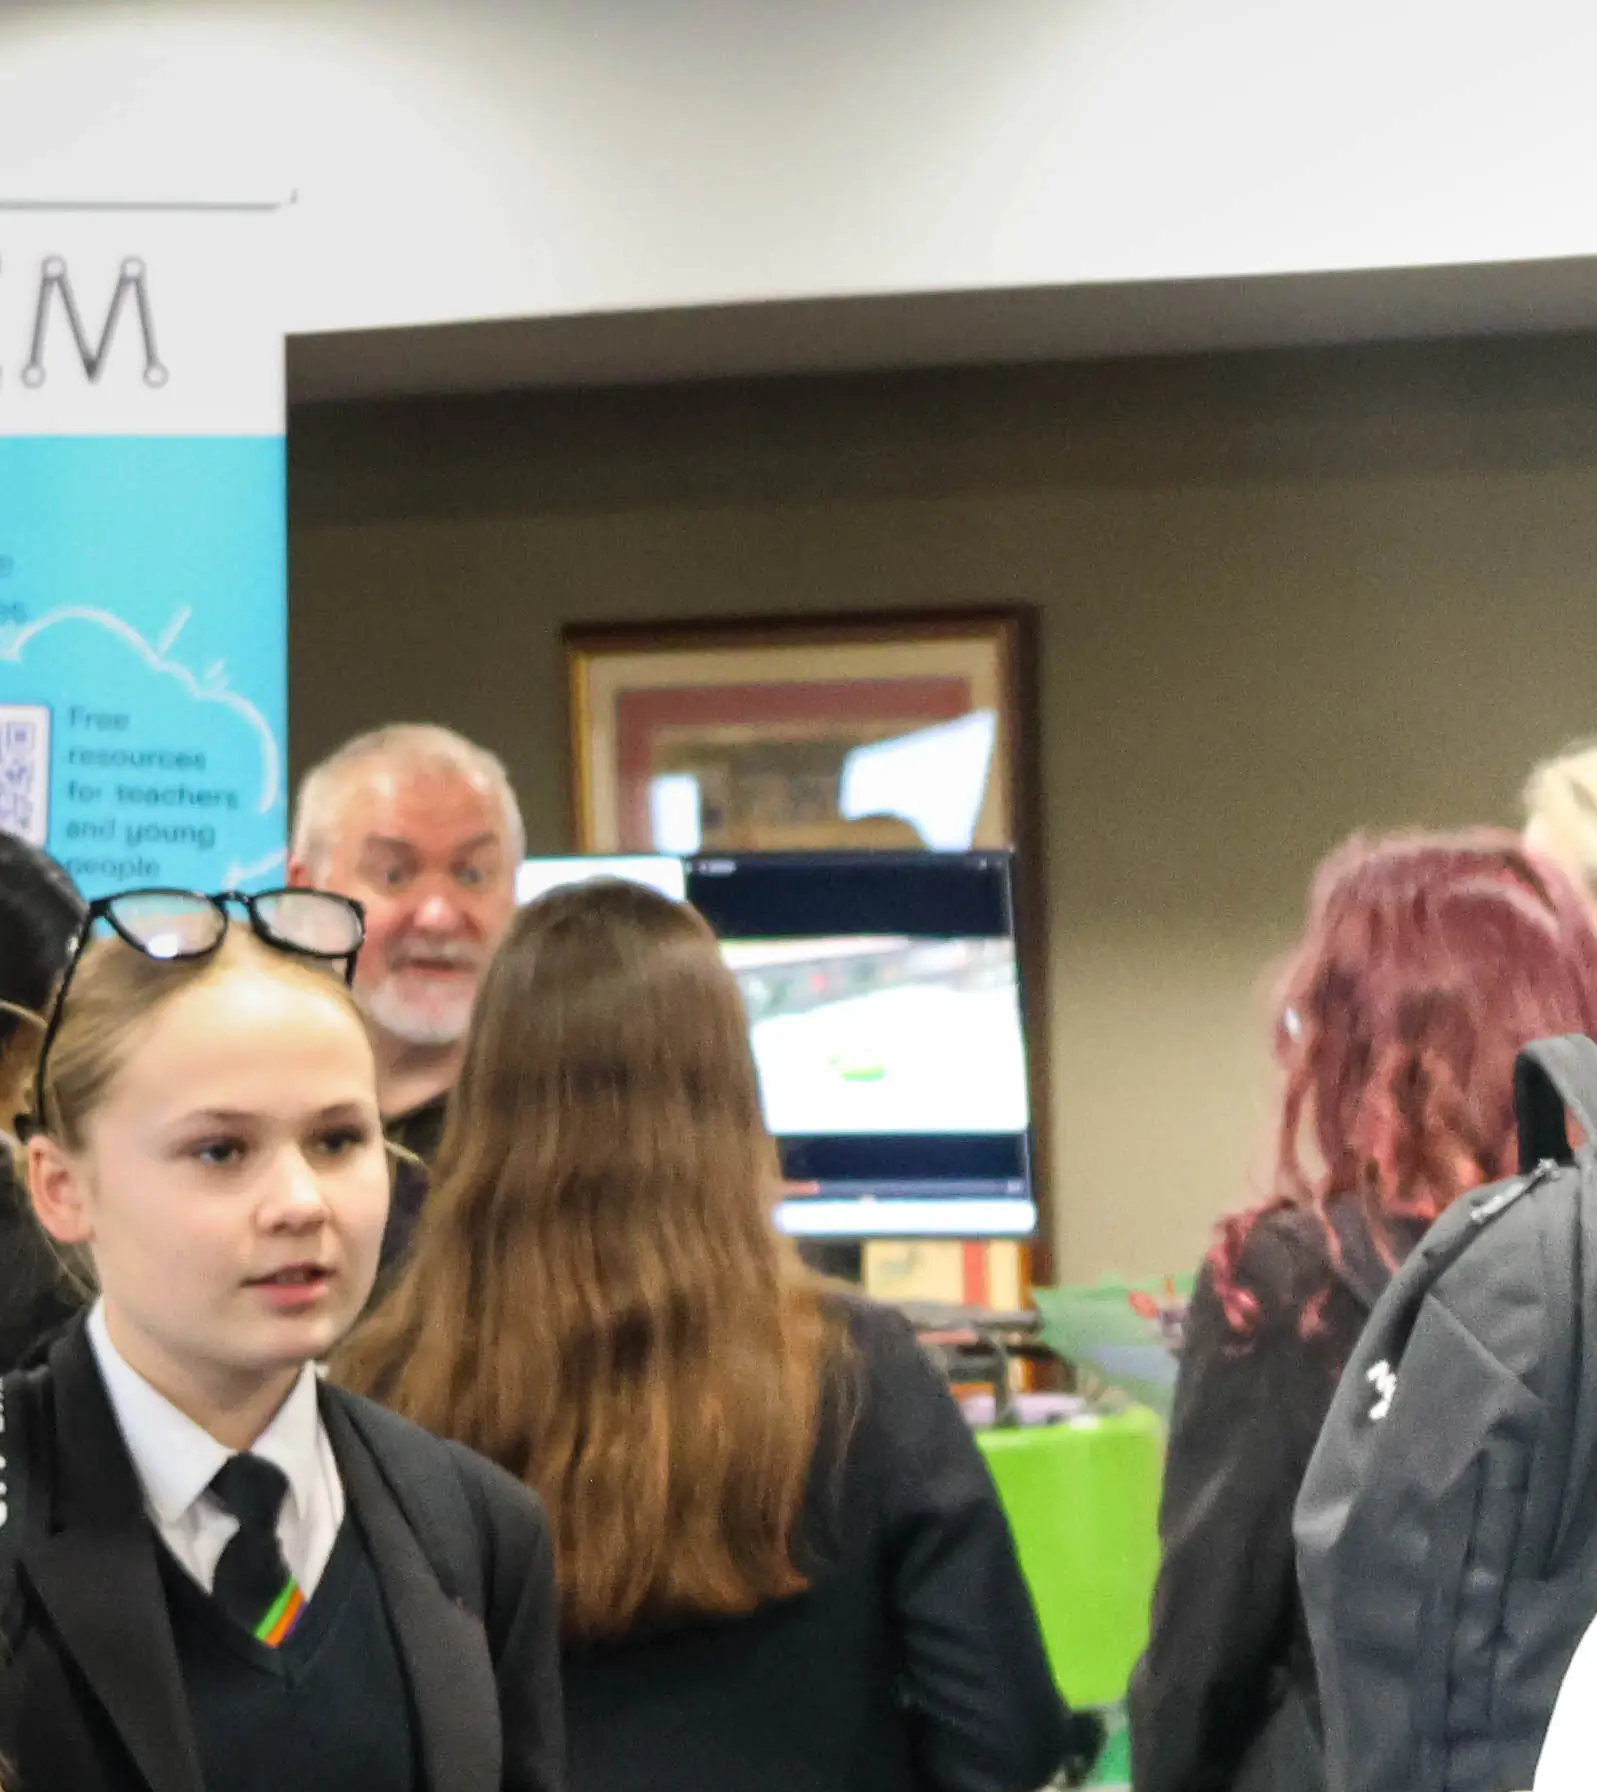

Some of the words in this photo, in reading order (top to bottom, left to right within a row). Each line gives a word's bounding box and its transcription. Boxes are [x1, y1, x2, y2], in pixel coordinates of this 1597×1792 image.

[67, 707, 130, 731] Free
[67, 748, 207, 770] resources
[67, 779, 102, 802] for
[116, 782, 239, 810] teachers
[65, 816, 116, 841] and
[125, 820, 216, 849] young
[66, 857, 161, 882] people
